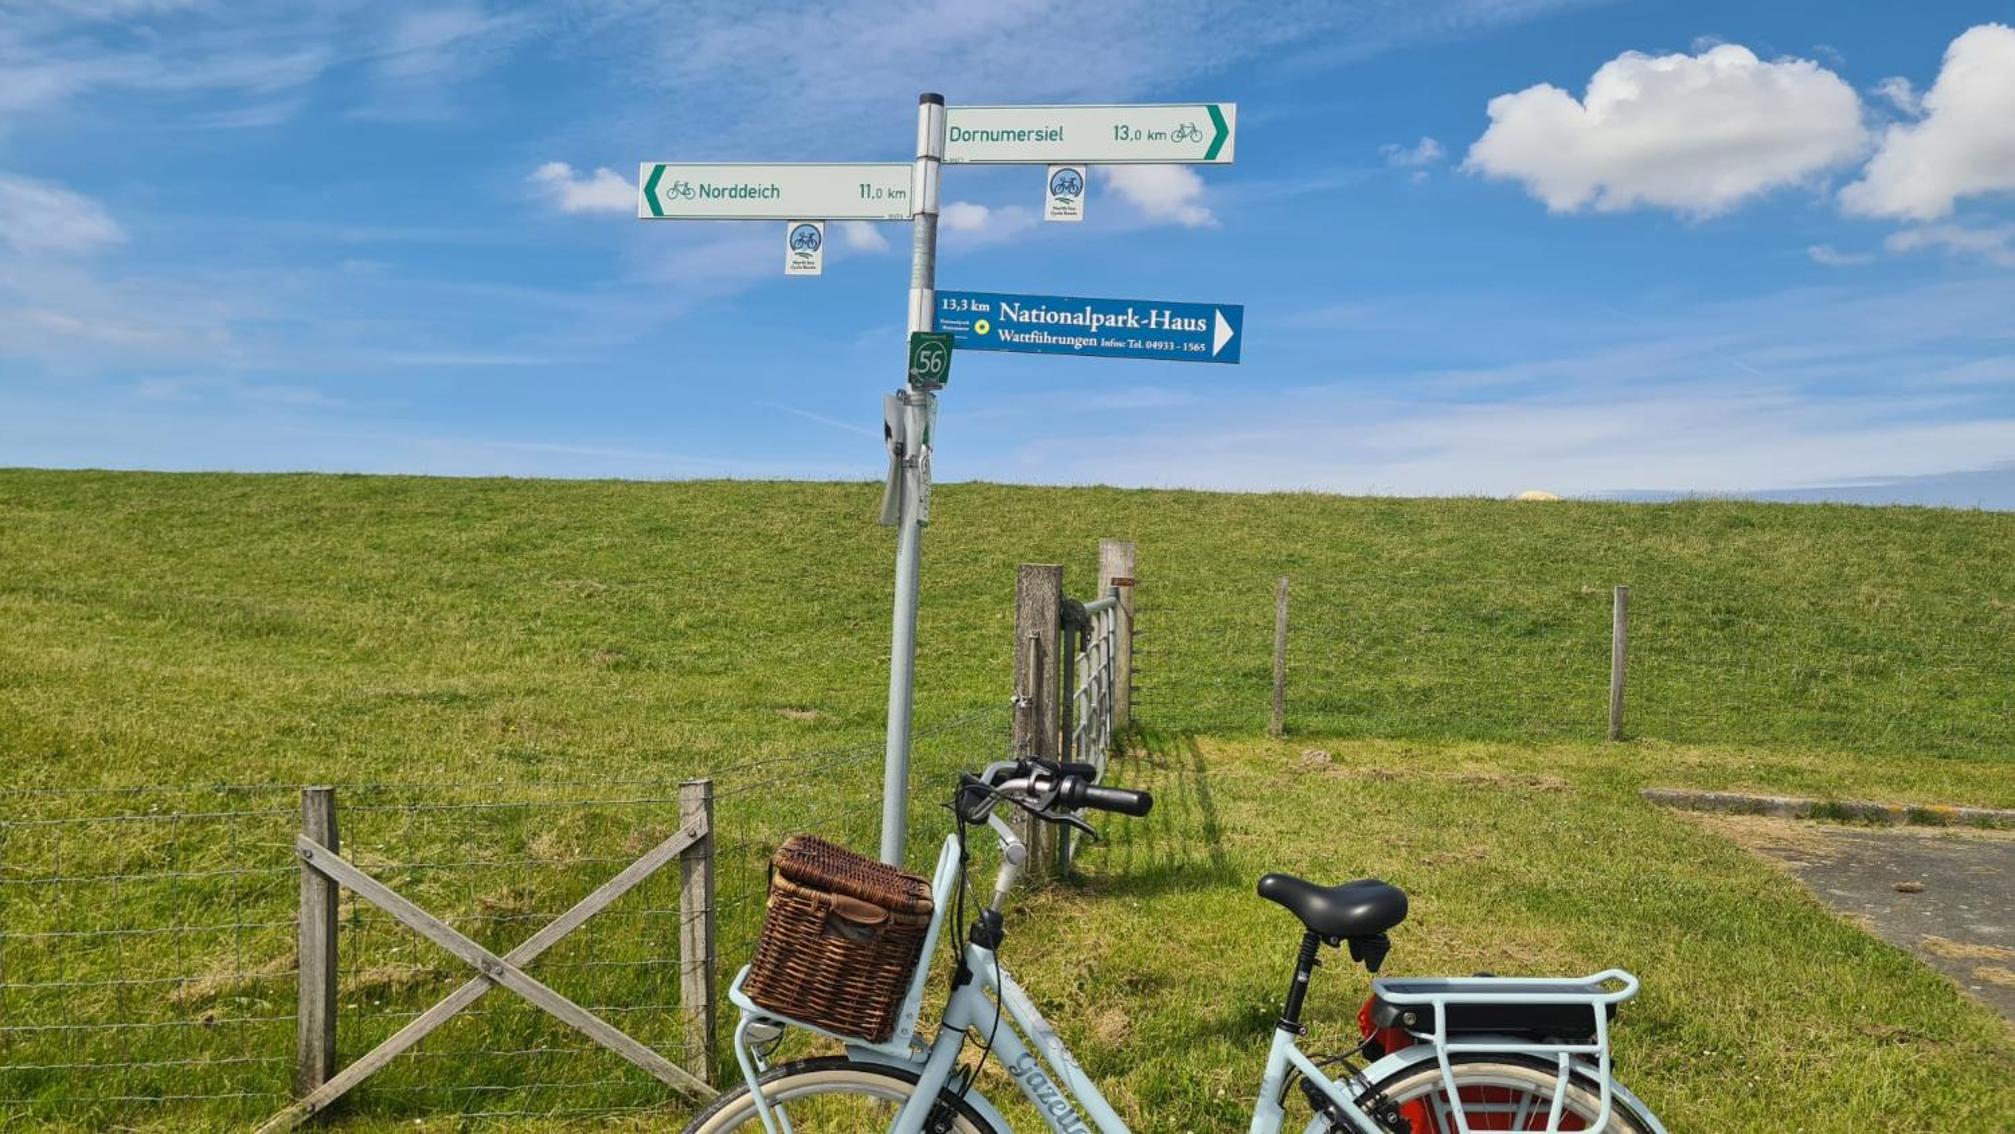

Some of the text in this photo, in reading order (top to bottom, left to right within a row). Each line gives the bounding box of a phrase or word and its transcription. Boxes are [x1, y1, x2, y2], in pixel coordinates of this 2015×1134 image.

[949, 125, 1065, 142] Dornumersiel
[1147, 129, 1167, 141] km
[699, 183, 780, 200] Norddeich
[888, 187, 906, 199] km
[942, 298, 990, 312] 13,3 km
[998, 301, 1208, 335] Nationalpark-Haus
[998, 328, 1098, 350] Wattführungen
[1145, 339, 1175, 352] 04933
[1182, 341, 1206, 353] 1565
[918, 350, 944, 374] 56
